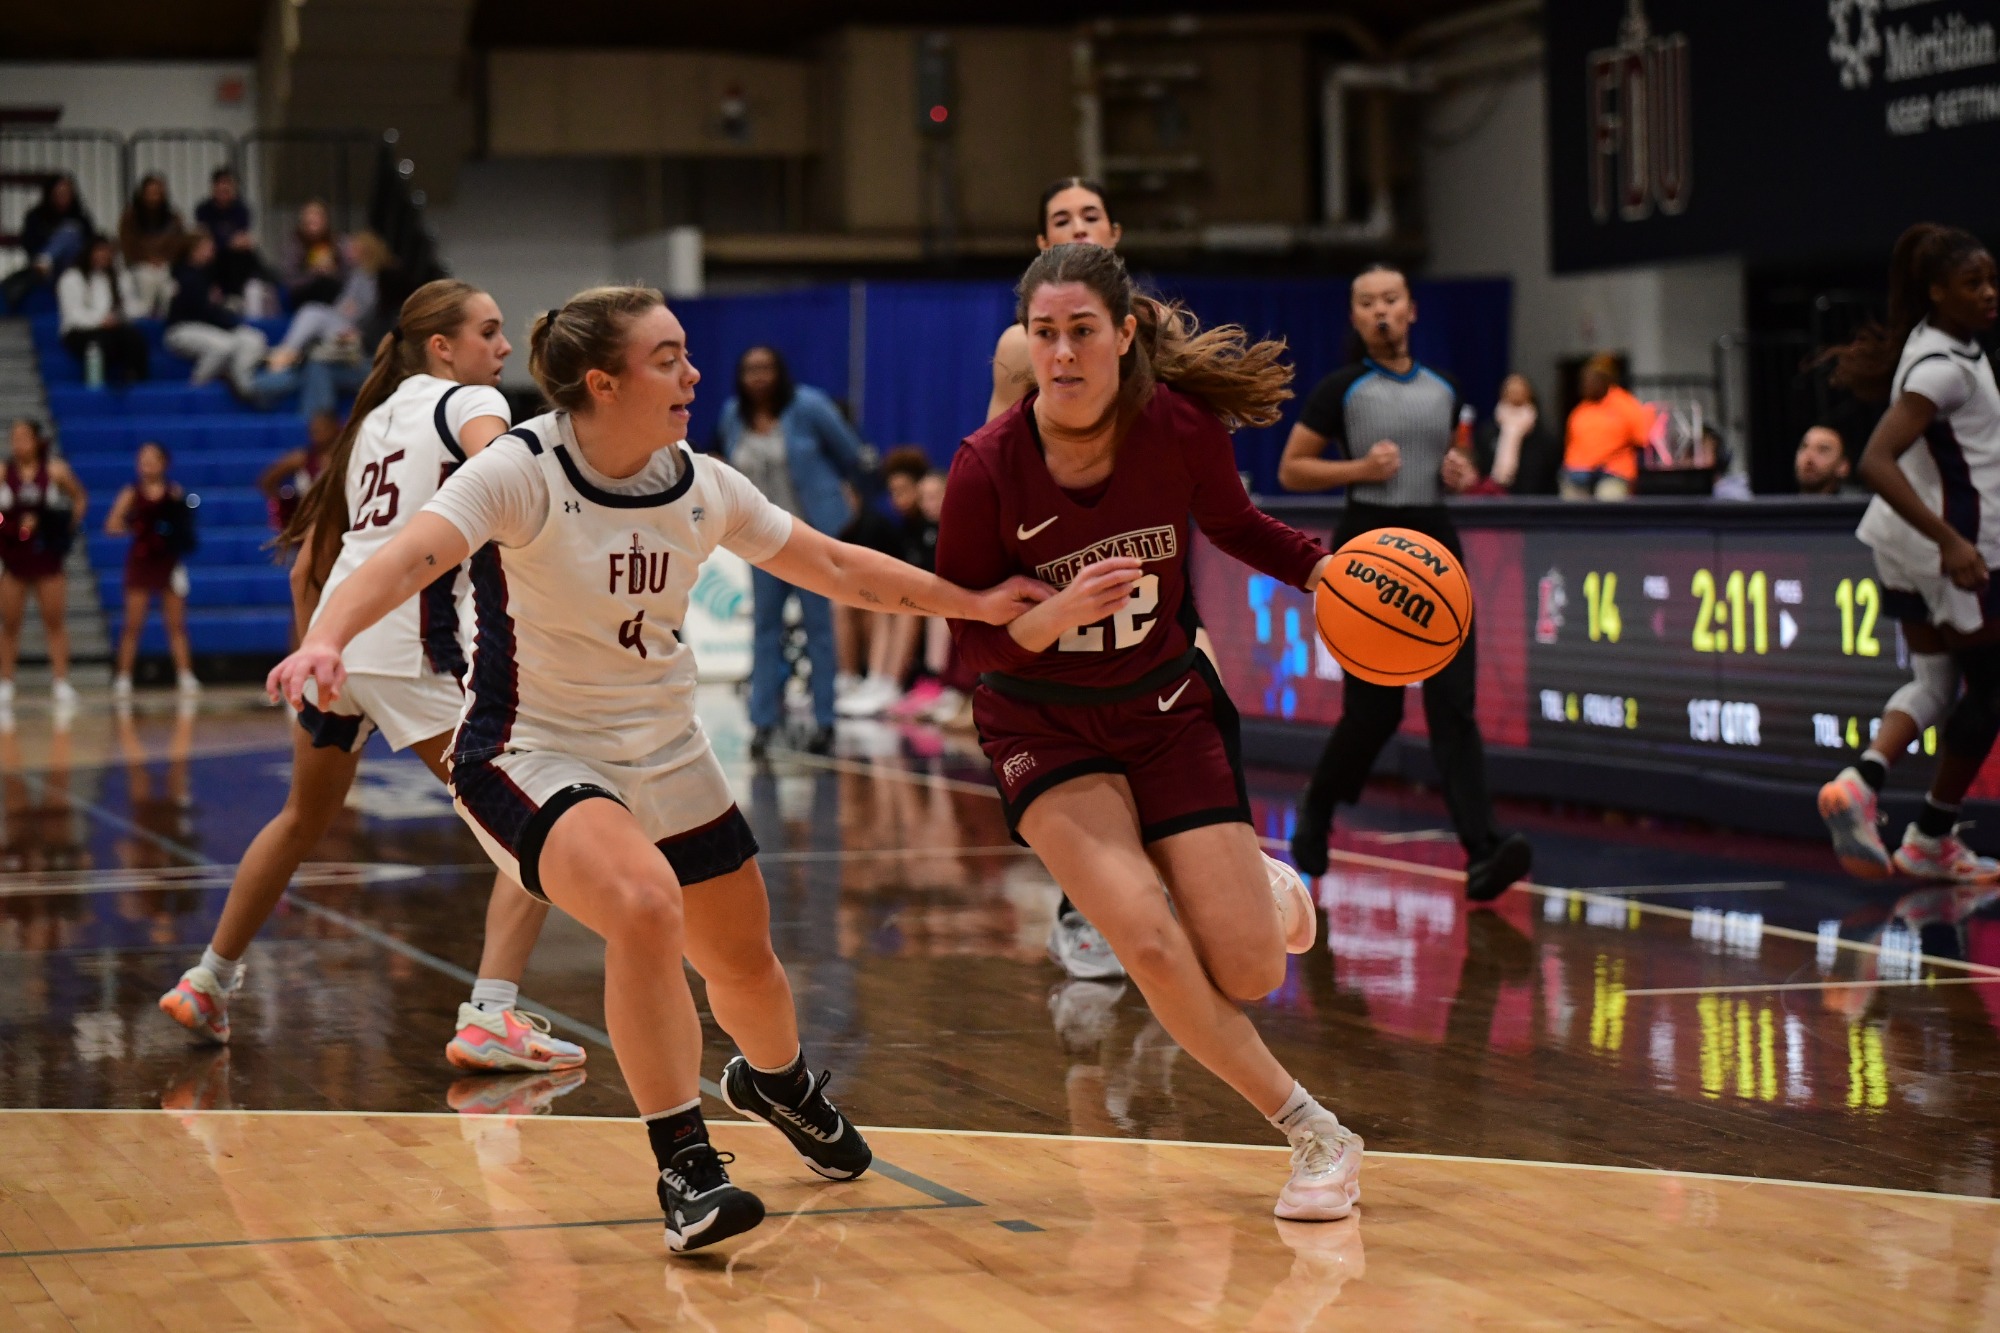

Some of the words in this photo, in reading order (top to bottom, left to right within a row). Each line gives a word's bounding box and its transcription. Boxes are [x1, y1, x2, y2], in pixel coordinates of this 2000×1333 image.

[1885, 13, 1996, 82] Meridian
[1587, 34, 1689, 223] FDU
[352, 449, 405, 531] 25
[609, 551, 670, 595] FDU
[1376, 534, 1449, 577] NCAA
[1345, 558, 1435, 629] Wilson
[1691, 568, 1769, 655] 2:11
[1835, 577, 1881, 657] 12
[618, 609, 648, 660] 4
[1624, 697, 1638, 729] 2
[1687, 698, 1721, 743] 1ST
[1721, 700, 1761, 746] QTR
